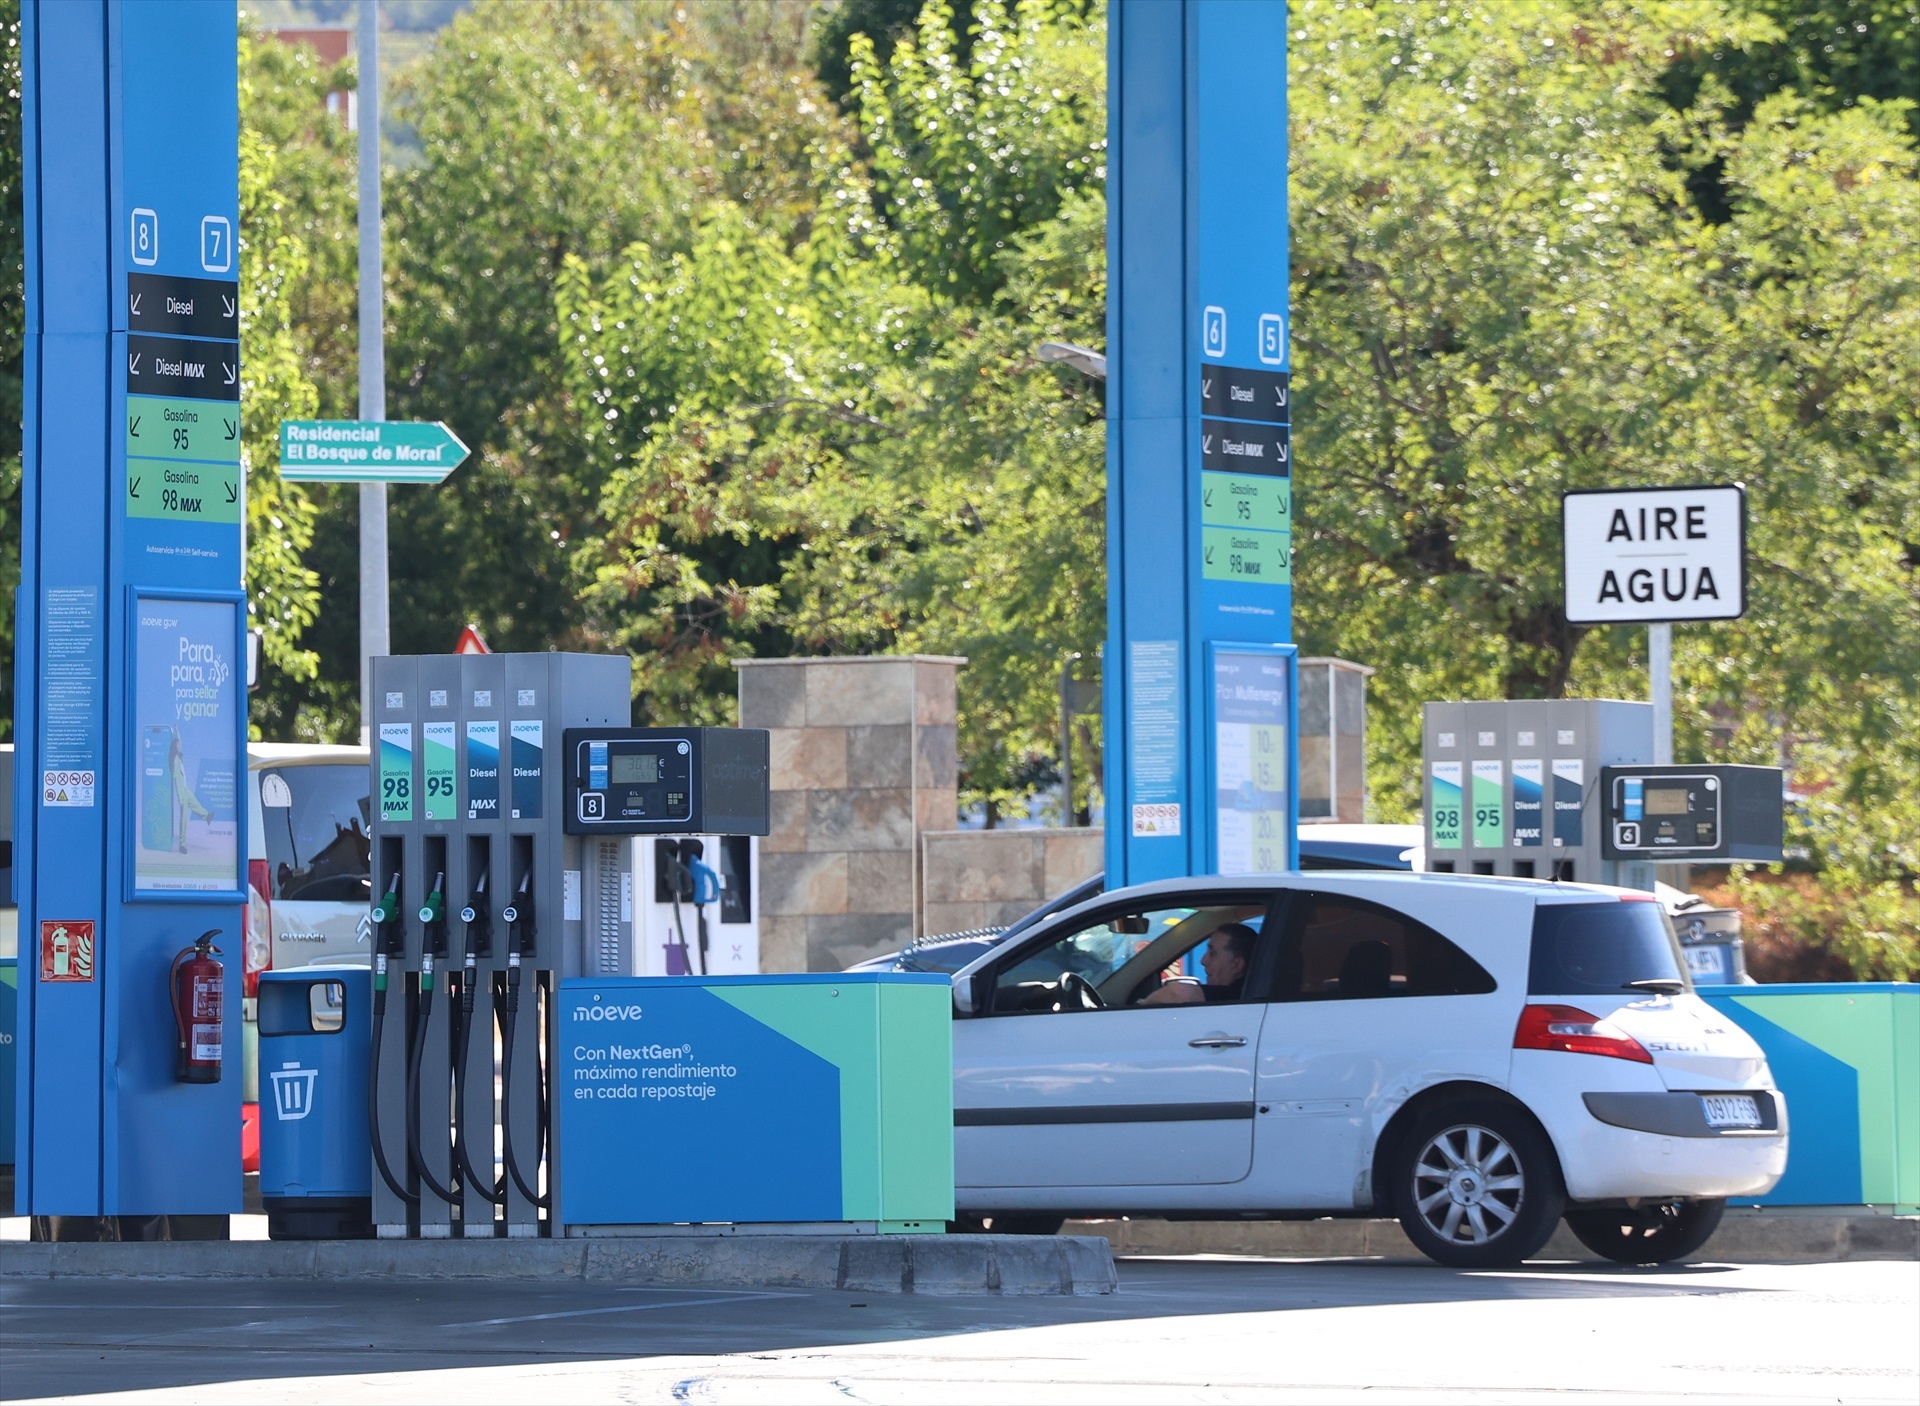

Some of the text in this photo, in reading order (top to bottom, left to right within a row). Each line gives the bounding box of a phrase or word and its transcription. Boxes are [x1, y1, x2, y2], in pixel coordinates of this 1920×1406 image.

[138, 222, 149, 251] 8
[210, 230, 221, 258] 7
[166, 296, 194, 316] Diesel
[1209, 319, 1220, 345] 6
[1265, 326, 1277, 352] 5
[155, 357, 206, 379] Diesel MAX
[1230, 385, 1255, 402] Diesel
[163, 407, 199, 424] Gasolina
[172, 427, 190, 451] 95
[286, 425, 380, 442] Residencial
[286, 444, 442, 463] El Bosque de Moral
[1222, 439, 1244, 456] Diesel
[163, 469, 199, 485] Gasolina
[1230, 482, 1258, 497] Gasolina
[161, 488, 203, 513] 98 MAX
[1237, 500, 1251, 520] 95
[1606, 505, 1708, 543] AIRE
[1230, 536, 1260, 551] Gasolina
[1230, 554, 1243, 574] 98
[1597, 566, 1720, 604] AGUA
[171, 664, 205, 688] para,
[176, 684, 219, 701] para sellar
[175, 702, 220, 721] y ganar
[382, 727, 409, 736] moeve
[426, 726, 453, 735] moeve
[469, 725, 496, 734] moeve
[512, 724, 540, 733] moeve
[1256, 730, 1270, 754] 10
[382, 768, 410, 777] Gasolina
[426, 768, 454, 776] Gasolina
[469, 768, 498, 778] Diesel
[513, 767, 541, 778] Diesel
[658, 770, 664, 779] L
[383, 777, 410, 799] 98
[427, 776, 454, 798] 95
[383, 800, 409, 812] MAX
[470, 798, 497, 810] MAX
[588, 799, 598, 814] 8
[1514, 802, 1540, 810] Diesel
[1554, 802, 1581, 810] Diesel
[1435, 810, 1459, 828] 98
[1476, 810, 1500, 827] 95
[1258, 815, 1272, 840] 20
[1434, 831, 1458, 840] MAX
[1515, 828, 1541, 838] MAX
[1622, 828, 1634, 842] 6
[573, 1004, 642, 1022] moeve
[574, 1045, 606, 1061] Con
[574, 1063, 737, 1080] máximo rendimiento
[574, 1082, 716, 1102] en cada repostaje
[1706, 1097, 1738, 1120] 0912
